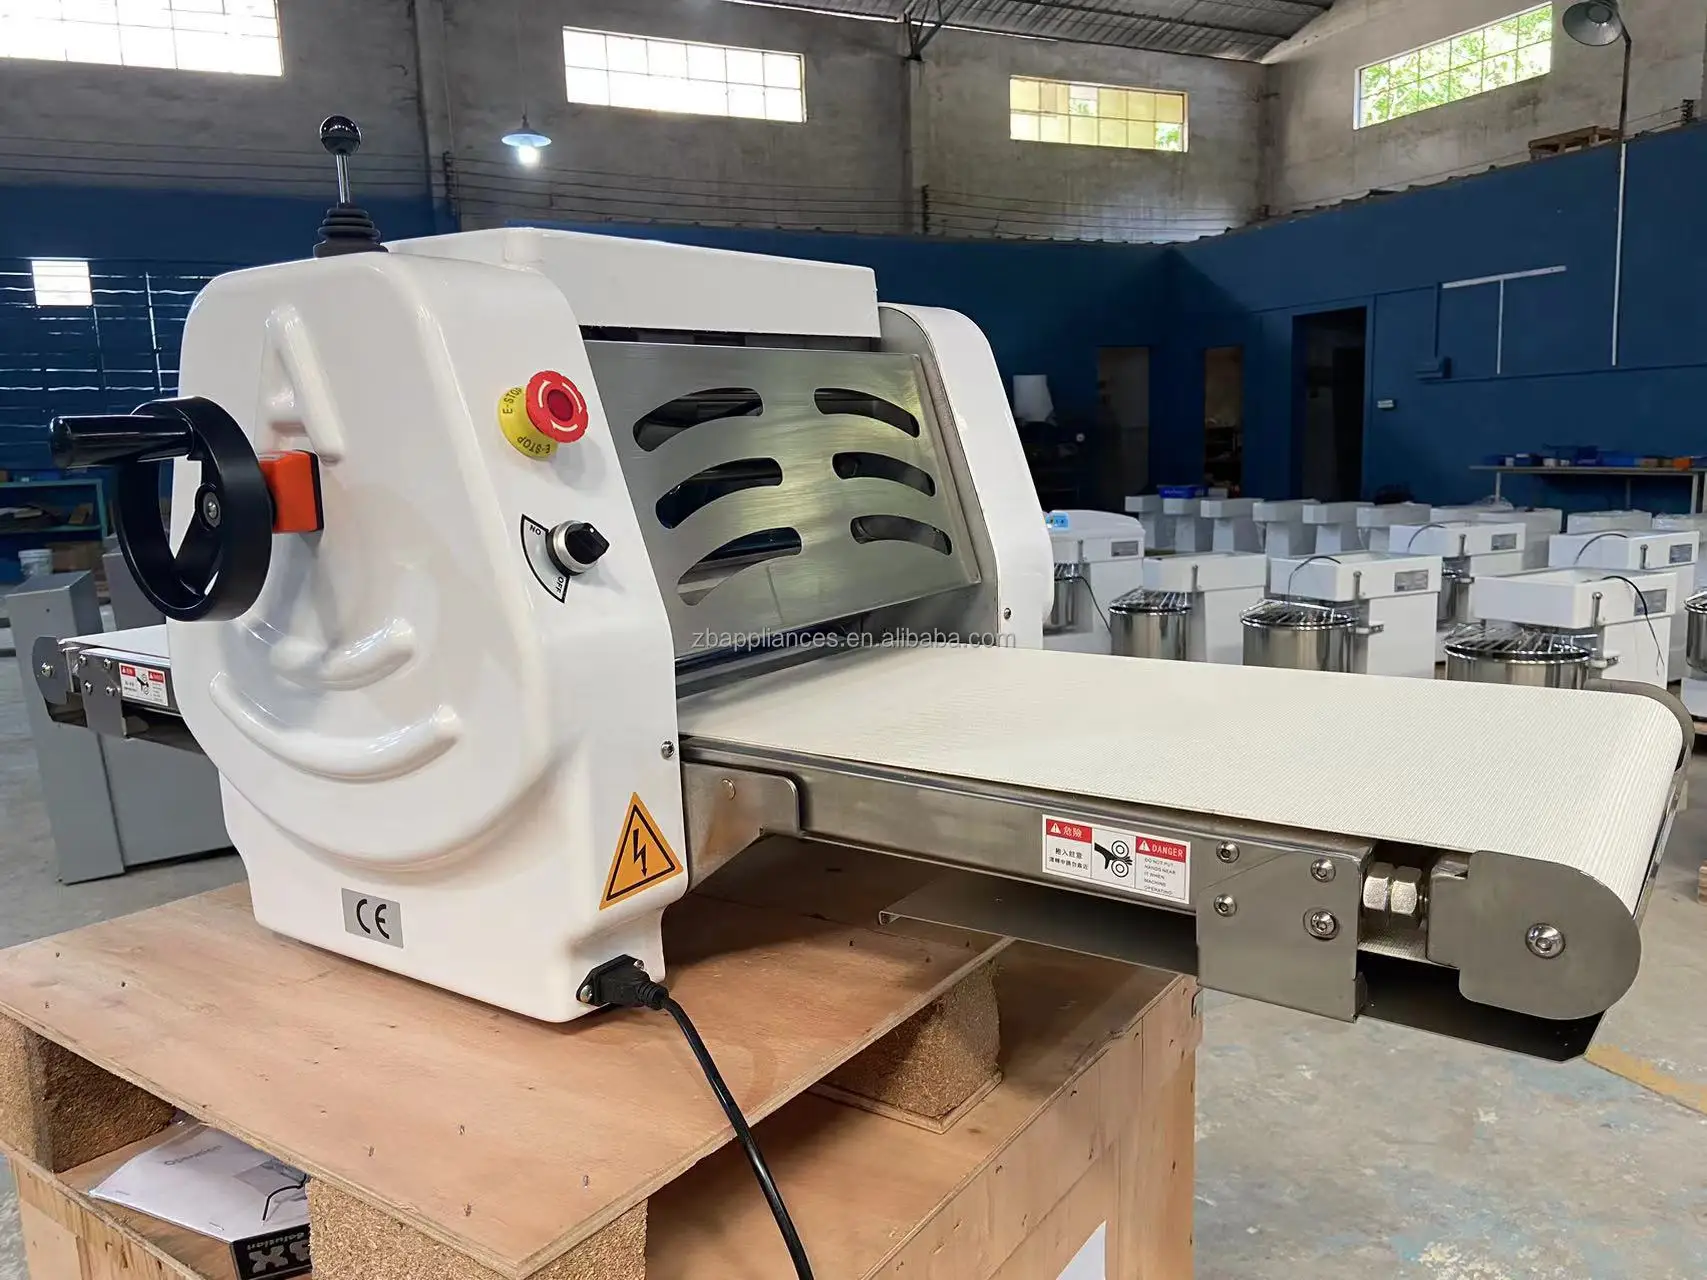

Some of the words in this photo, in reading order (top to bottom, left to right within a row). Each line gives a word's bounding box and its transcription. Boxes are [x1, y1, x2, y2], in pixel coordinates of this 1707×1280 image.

[517, 436, 551, 454] E-STOP
[529, 525, 541, 536] ON
[556, 576, 564, 593] OFF
[1063, 825, 1082, 838] 危險
[1151, 843, 1184, 857] DANGER
[1144, 864, 1161, 872] HANDS
[1144, 878, 1166, 887] MACHINE
[356, 898, 390, 939] CE
